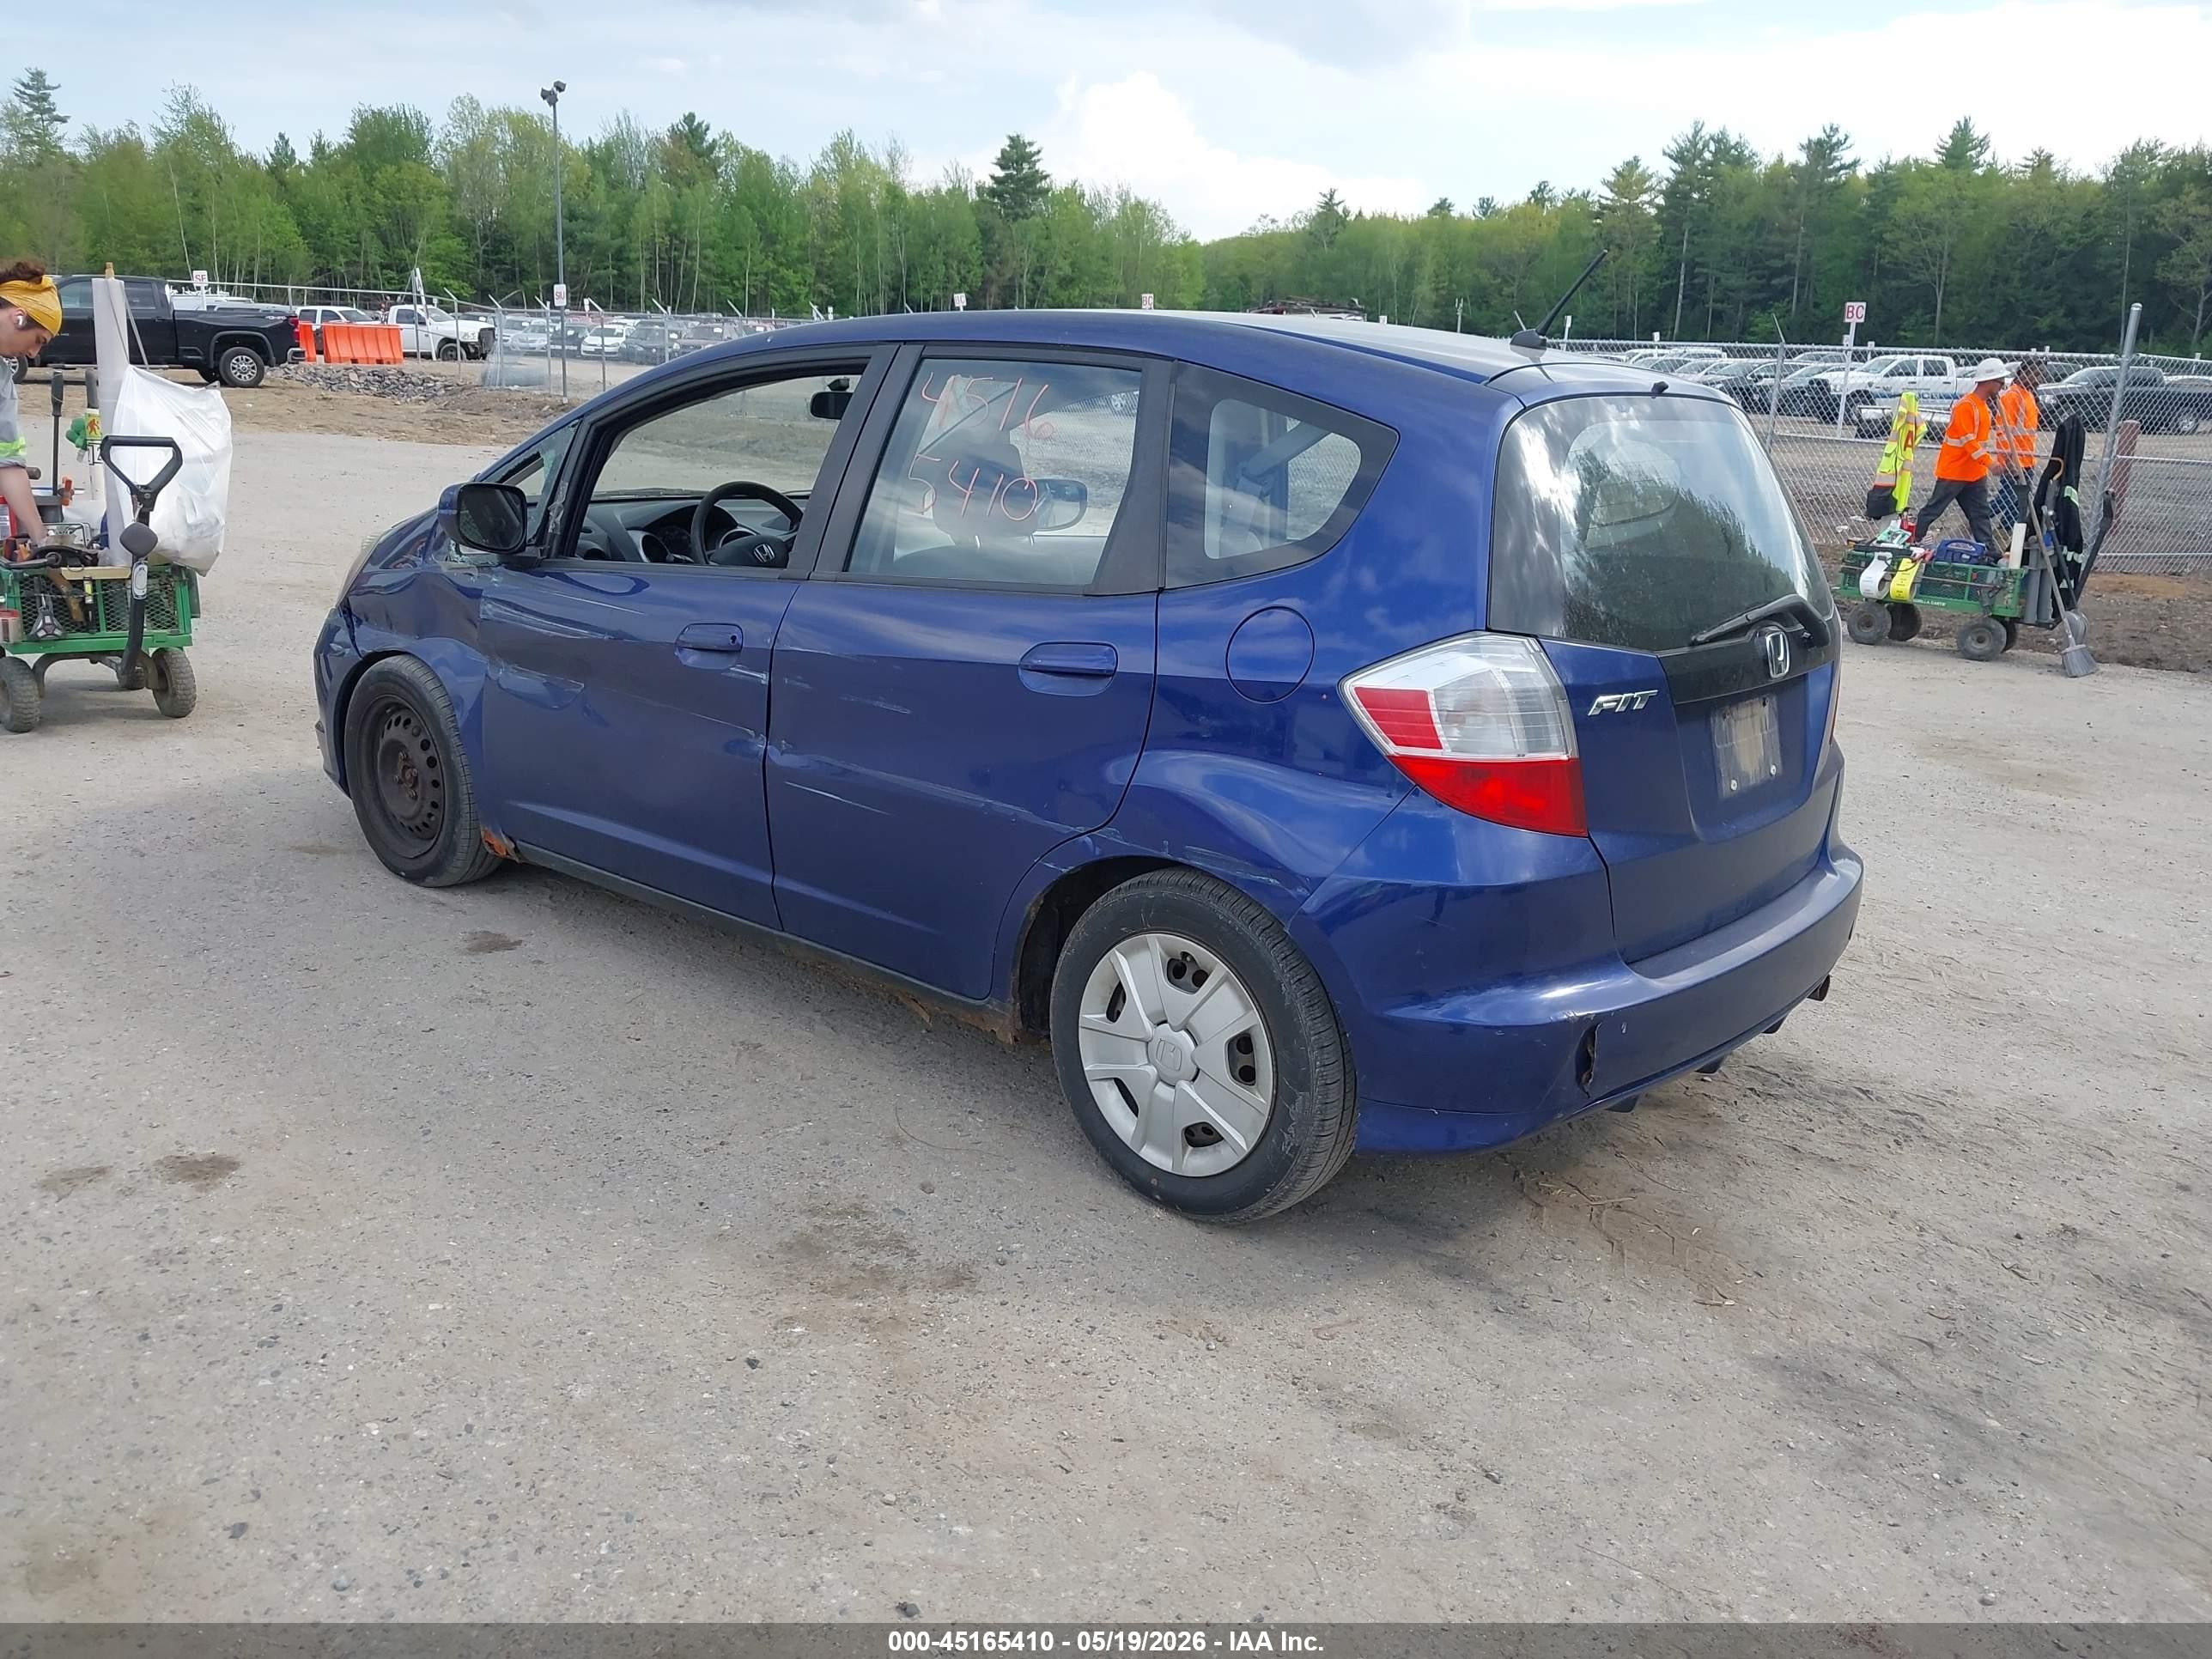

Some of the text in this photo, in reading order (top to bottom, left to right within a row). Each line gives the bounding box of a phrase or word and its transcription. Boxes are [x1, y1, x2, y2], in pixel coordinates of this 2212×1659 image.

[1846, 305, 1864, 319] BC
[921, 371, 1057, 441] 4516
[908, 453, 1039, 521] 5410
[1587, 690, 1659, 716] FIT
